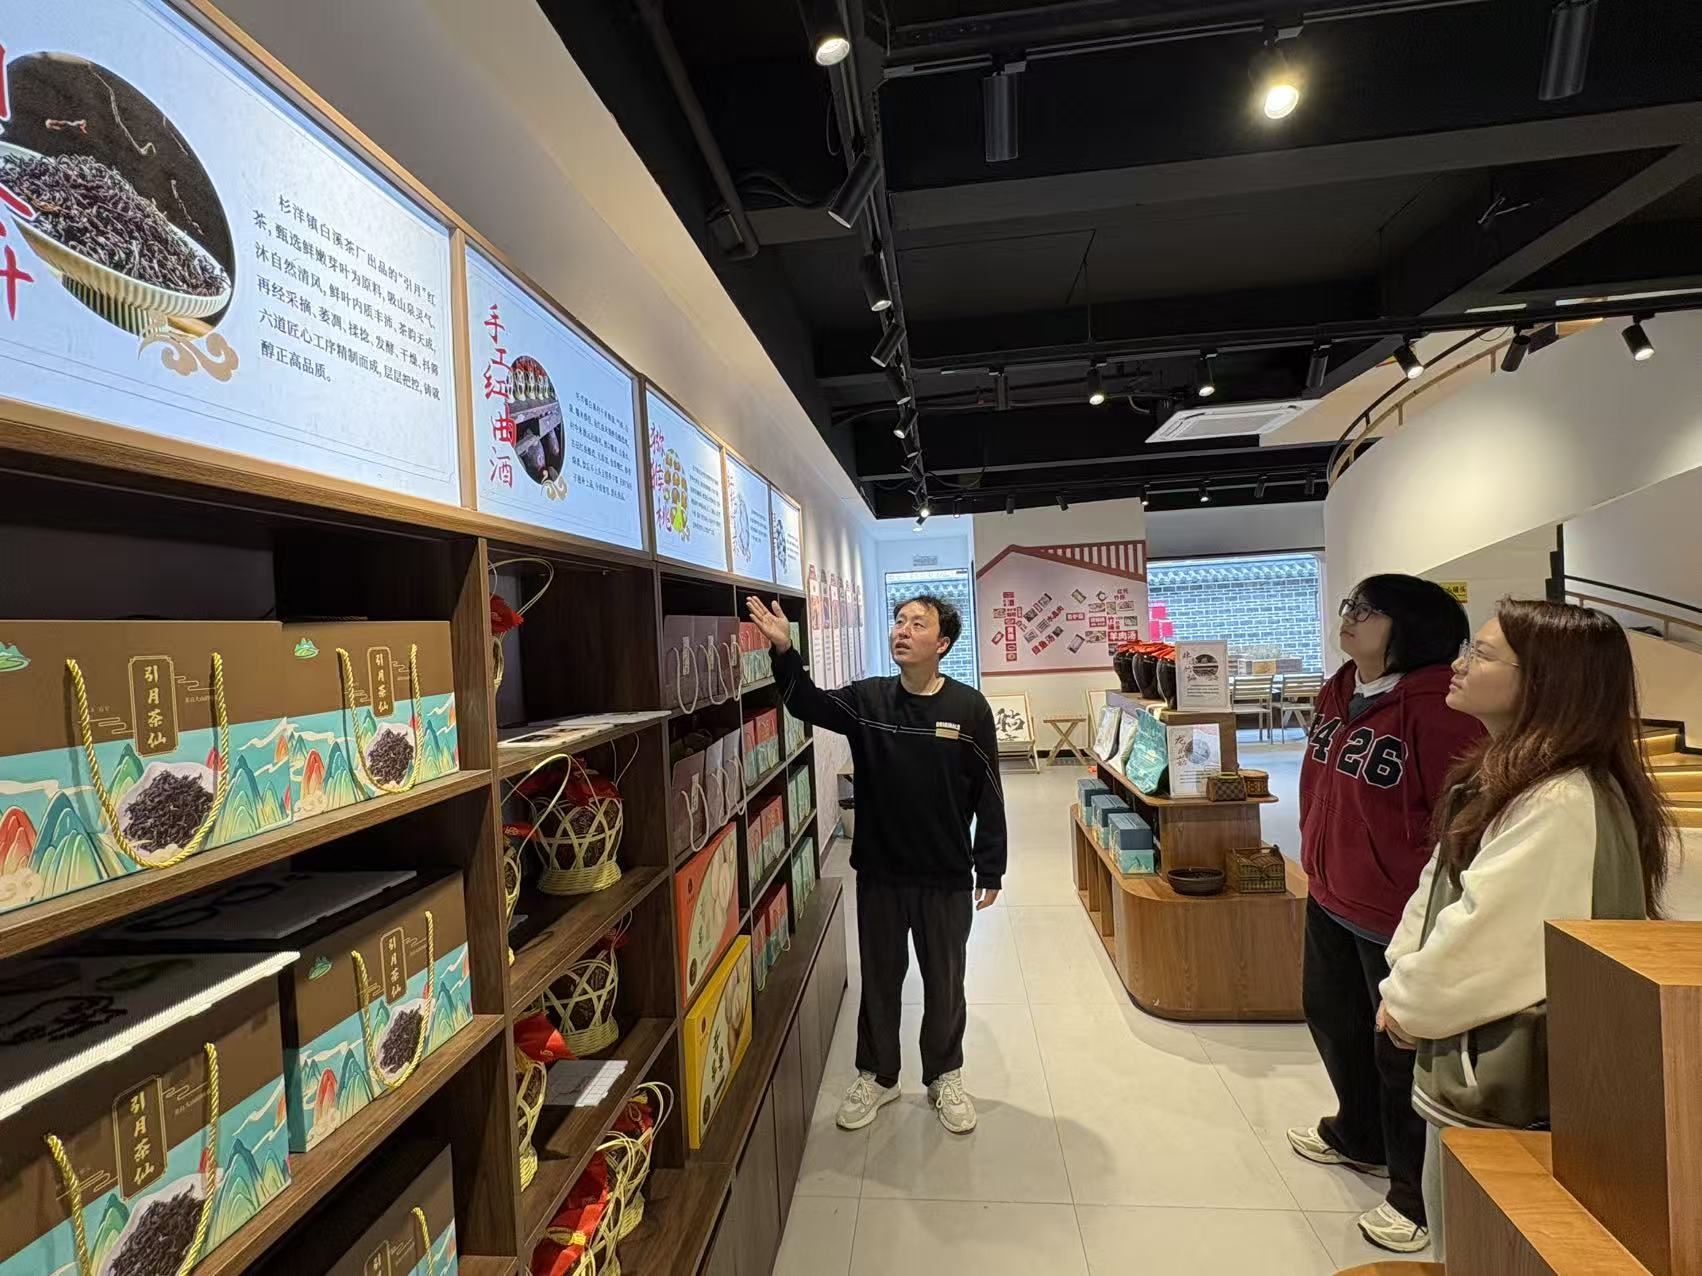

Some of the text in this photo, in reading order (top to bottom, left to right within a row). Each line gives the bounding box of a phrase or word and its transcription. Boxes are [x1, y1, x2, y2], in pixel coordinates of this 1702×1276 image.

[260, 338, 332, 382] 醇正高品质。
[483, 303, 517, 489] 手工红曲酒
[144, 664, 167, 750] 引月茶仙
[375, 653, 389, 714] 引月茶仙
[388, 935, 402, 999] 引月茶仙
[130, 1090, 155, 1186] 引月茶仙
